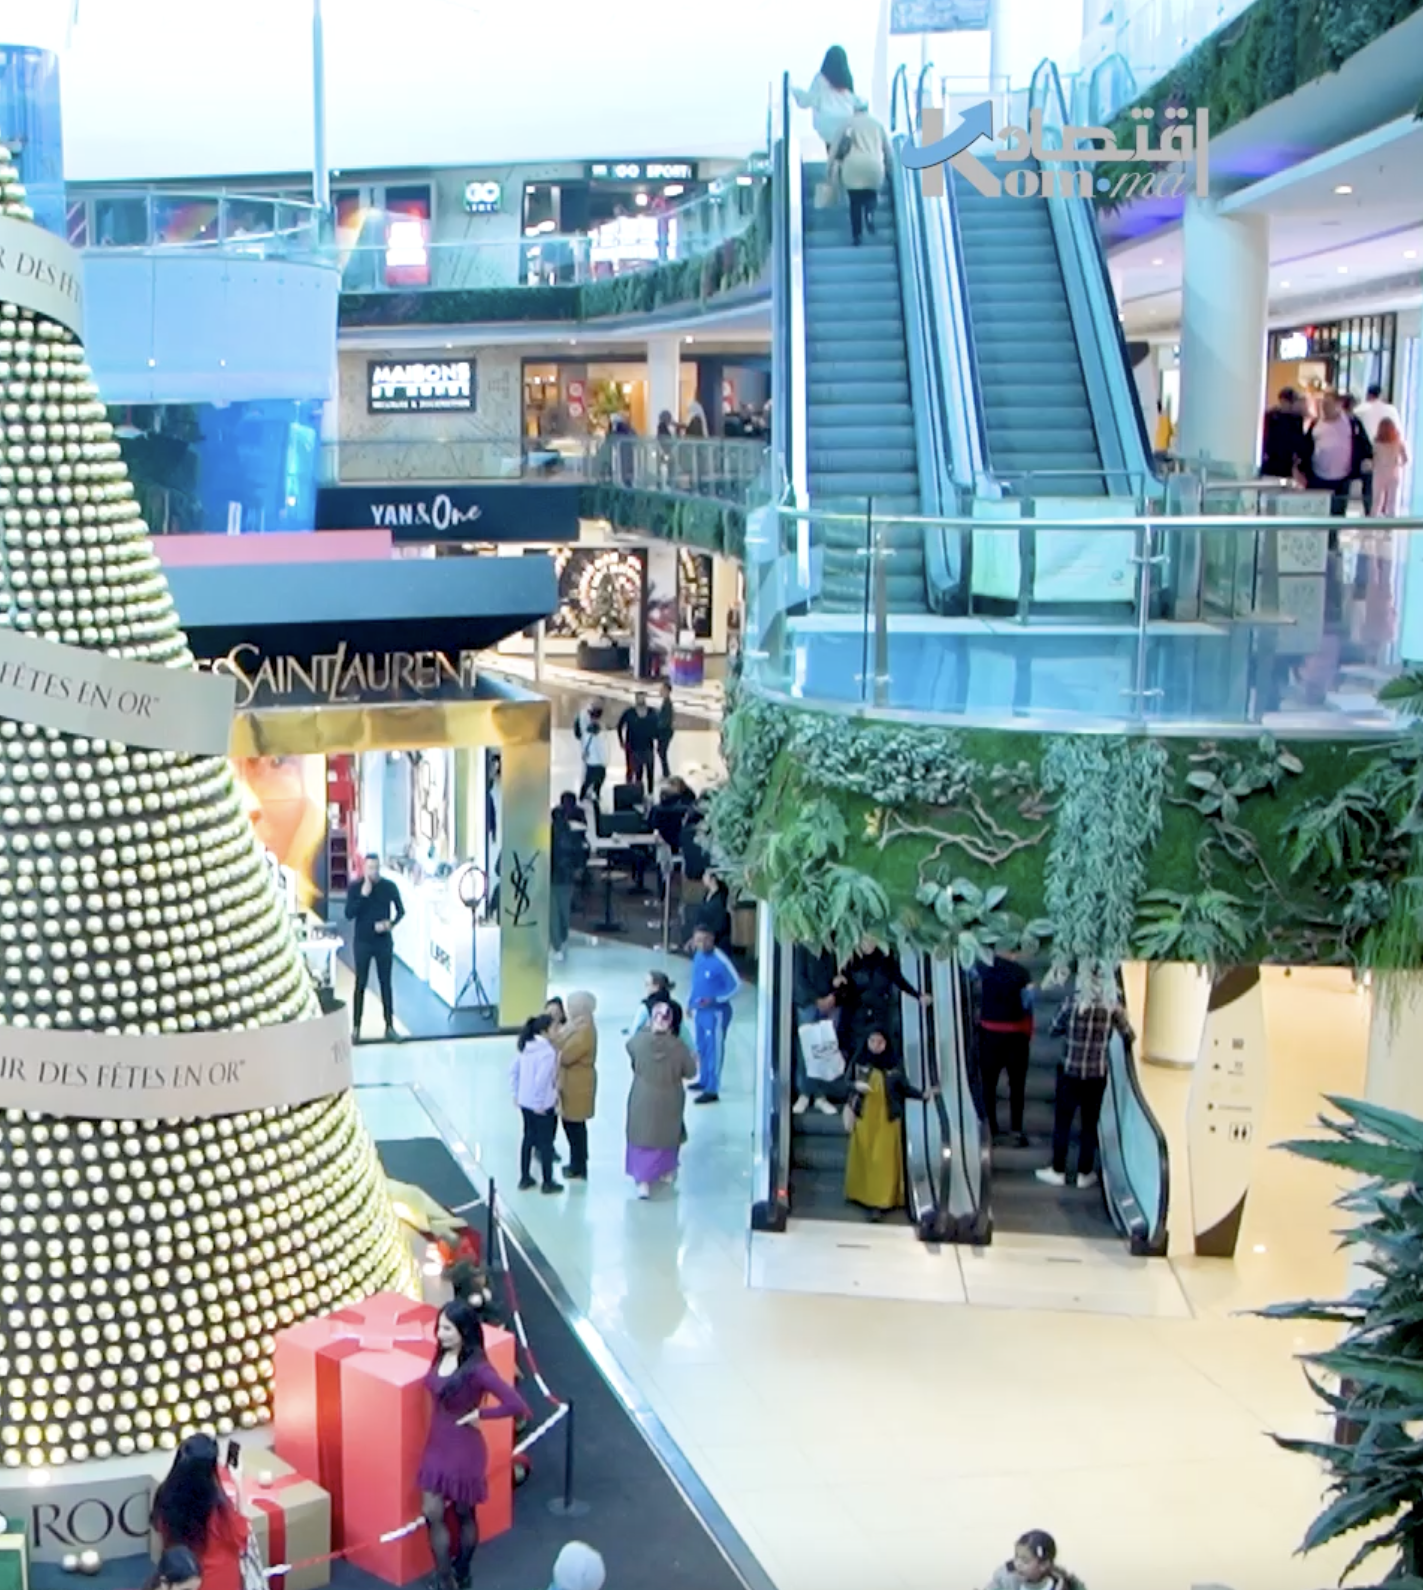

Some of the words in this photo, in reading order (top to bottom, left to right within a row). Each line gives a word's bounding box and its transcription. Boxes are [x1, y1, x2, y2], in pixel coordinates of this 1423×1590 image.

[77, 683, 113, 710] EN
[38, 1060, 89, 1088] DES
[96, 1061, 167, 1091] FÊTES
[172, 1062, 204, 1088] EN
